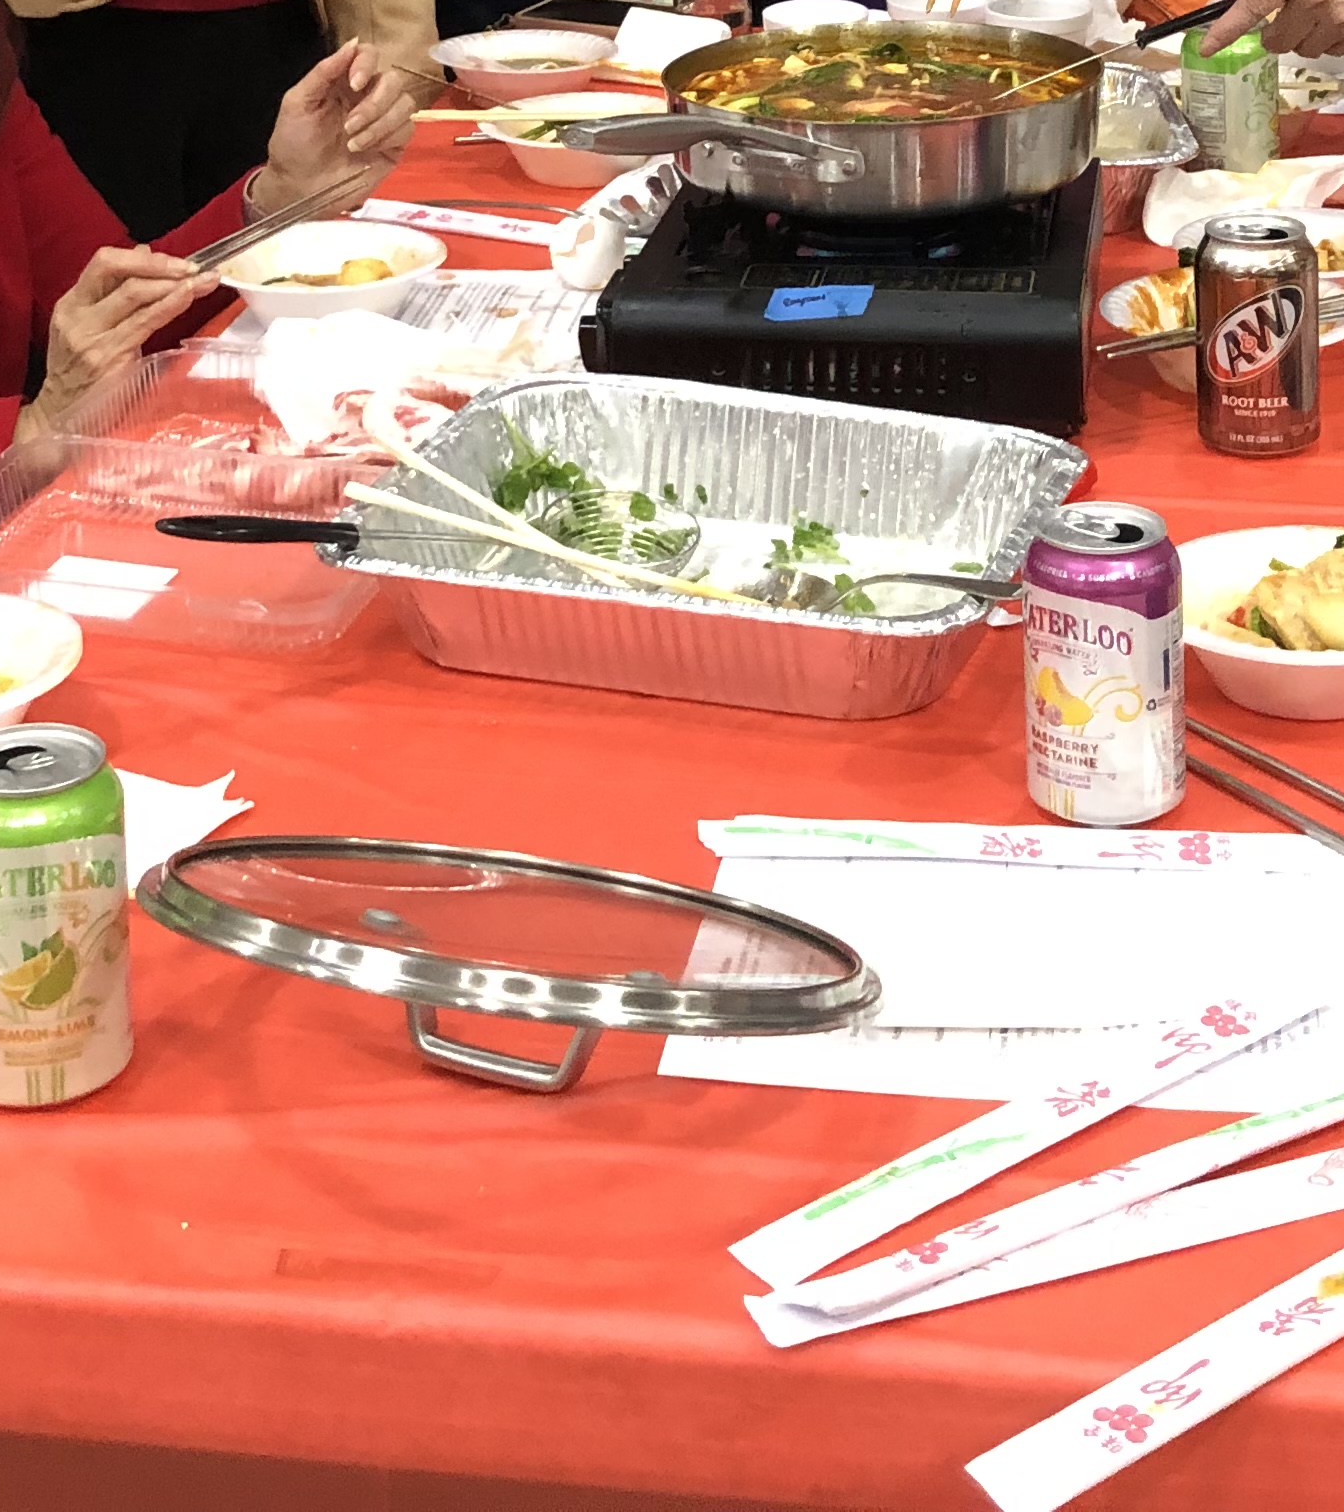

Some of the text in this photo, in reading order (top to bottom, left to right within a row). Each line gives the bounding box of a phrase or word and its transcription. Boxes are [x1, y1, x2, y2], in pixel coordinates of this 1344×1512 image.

[1222, 290, 1292, 378] A&W
[1221, 394, 1289, 408] ROOT BEER
[1027, 600, 1133, 656] ATERLOO
[1031, 724, 1099, 754] RASPBERRY
[1032, 739, 1099, 769] NECTARINE
